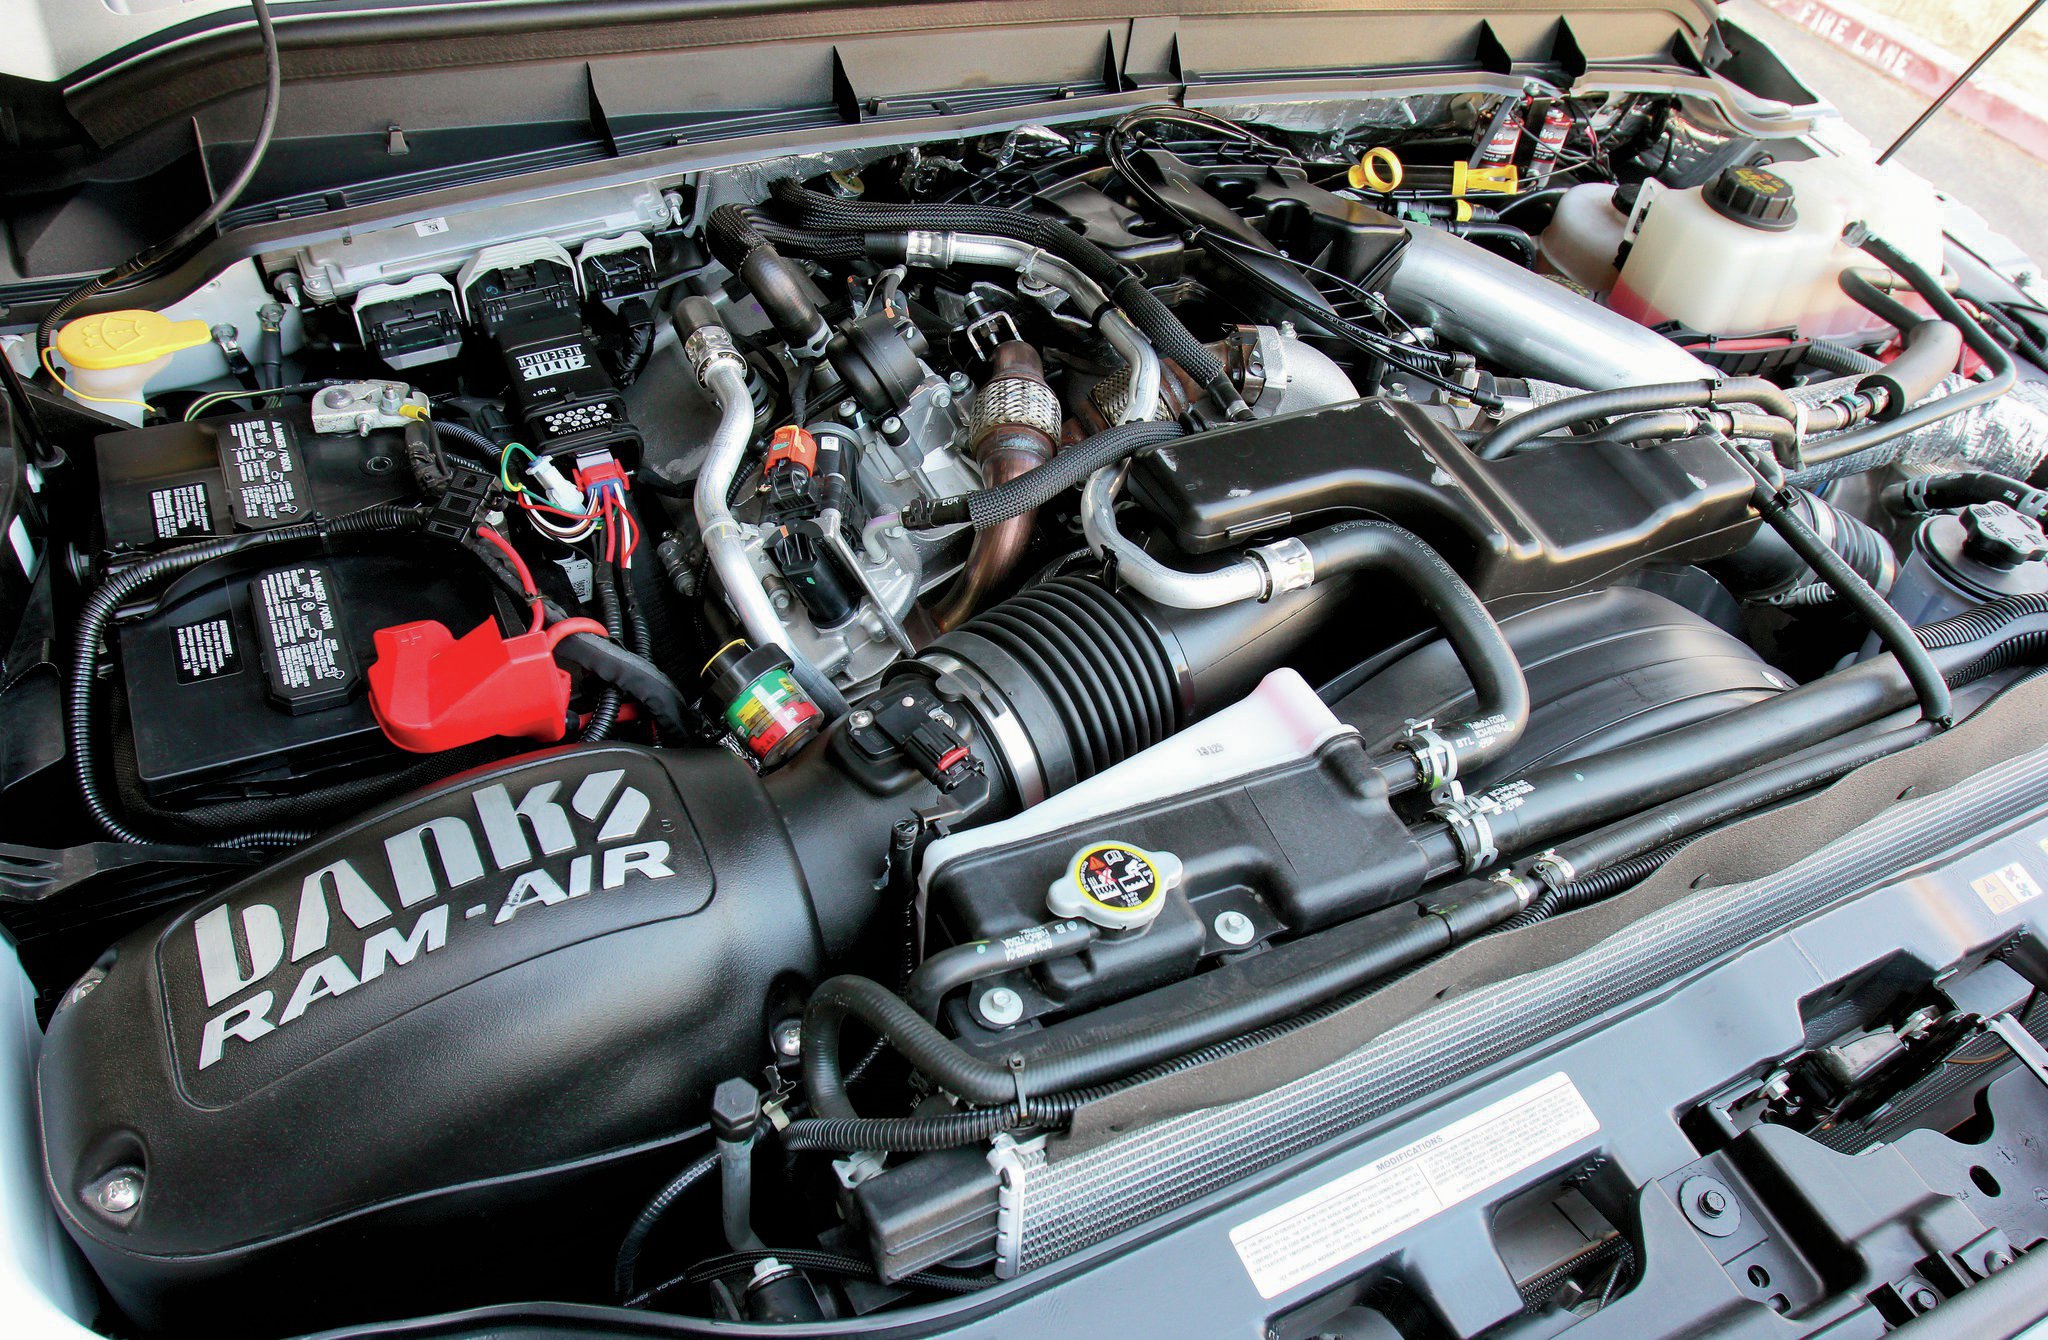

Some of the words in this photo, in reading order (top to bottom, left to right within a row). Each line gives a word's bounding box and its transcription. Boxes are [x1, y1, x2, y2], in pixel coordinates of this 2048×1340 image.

[1798, 1, 1852, 43] FIRE
[1852, 28, 1914, 79] LANE
[518, 346, 582, 368] RESEARCH
[941, 496, 959, 506] EGR
[1456, 737, 1475, 748] BTL
[199, 840, 676, 1070] RAM-AIR
[1376, 1134, 1444, 1172] MODIFICATIONS
